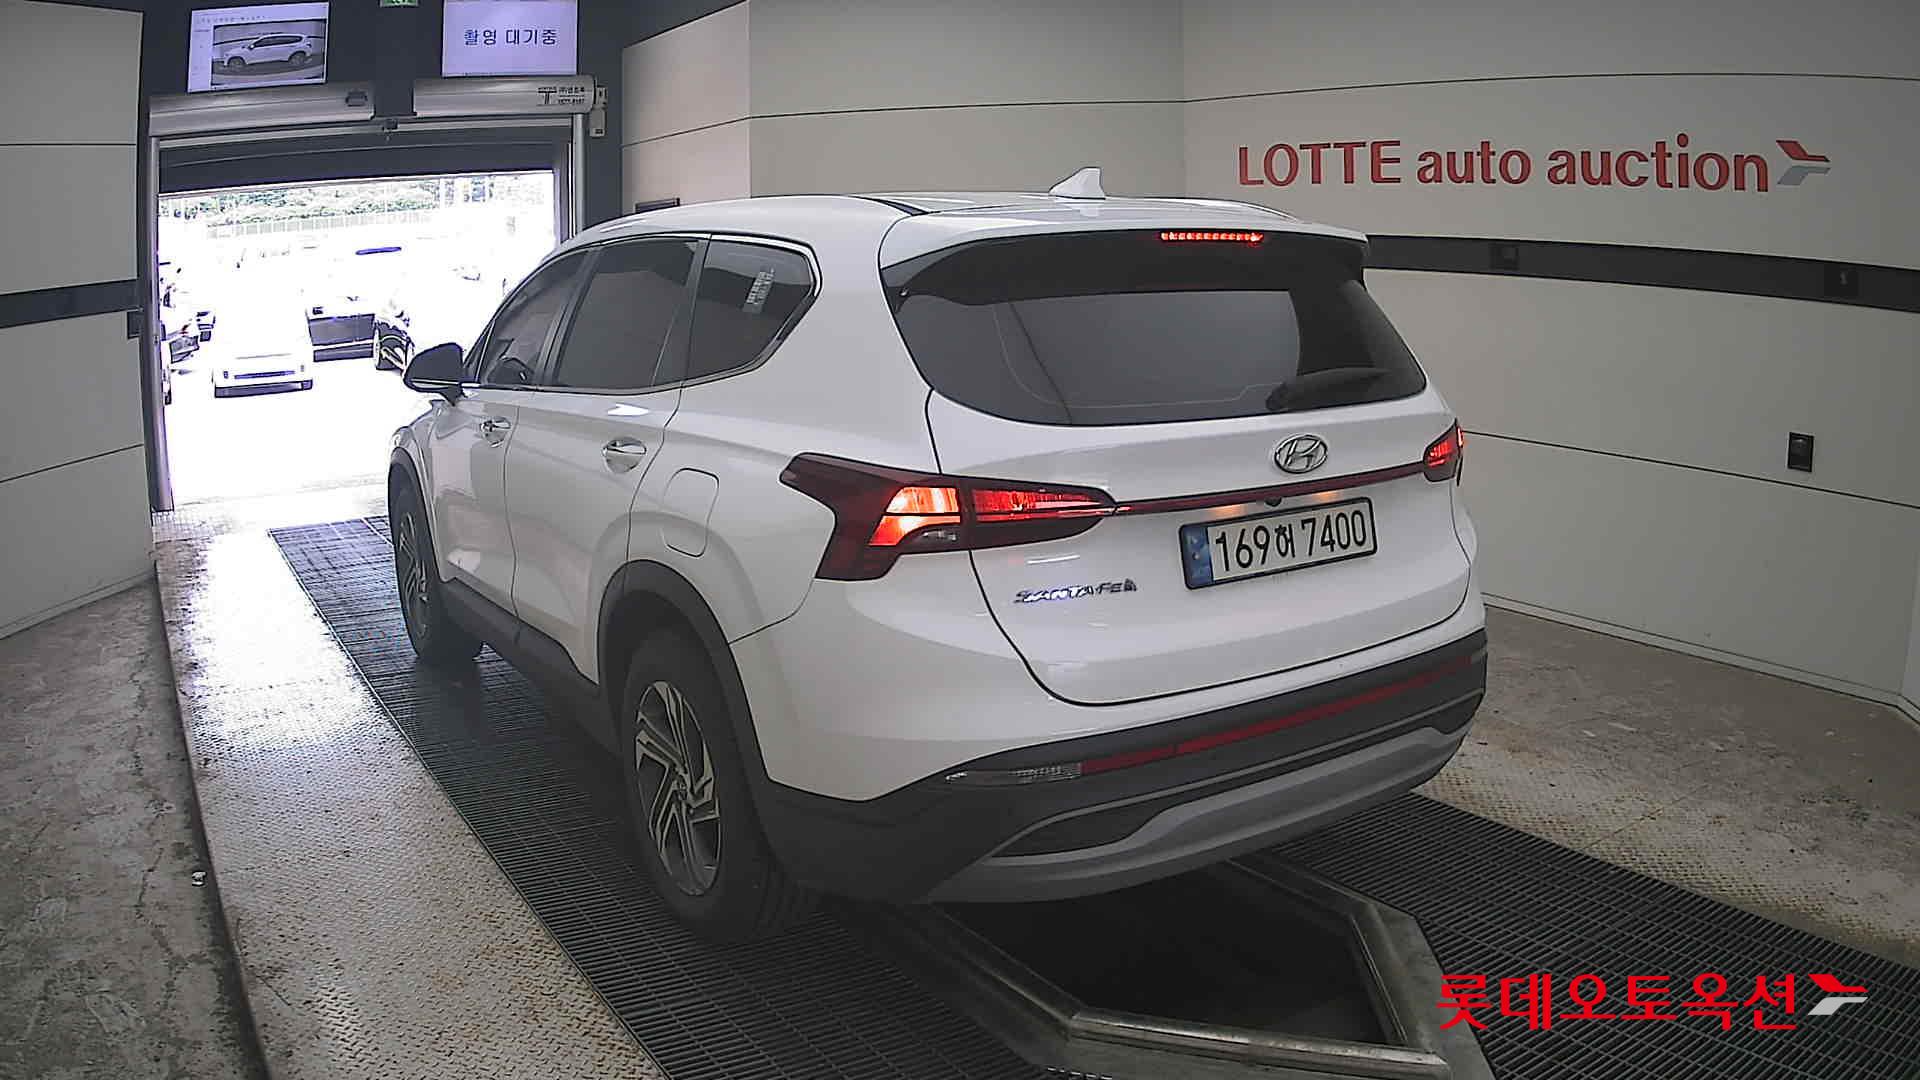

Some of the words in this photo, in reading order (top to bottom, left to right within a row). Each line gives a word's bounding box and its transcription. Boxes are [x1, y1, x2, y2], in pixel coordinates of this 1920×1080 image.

[505, 29, 558, 46] 대기중
[1238, 140, 1402, 187] LOTTE
[1416, 141, 1532, 184] auto
[1547, 133, 1769, 192] auction
[1300, 510, 1367, 556] 7400
